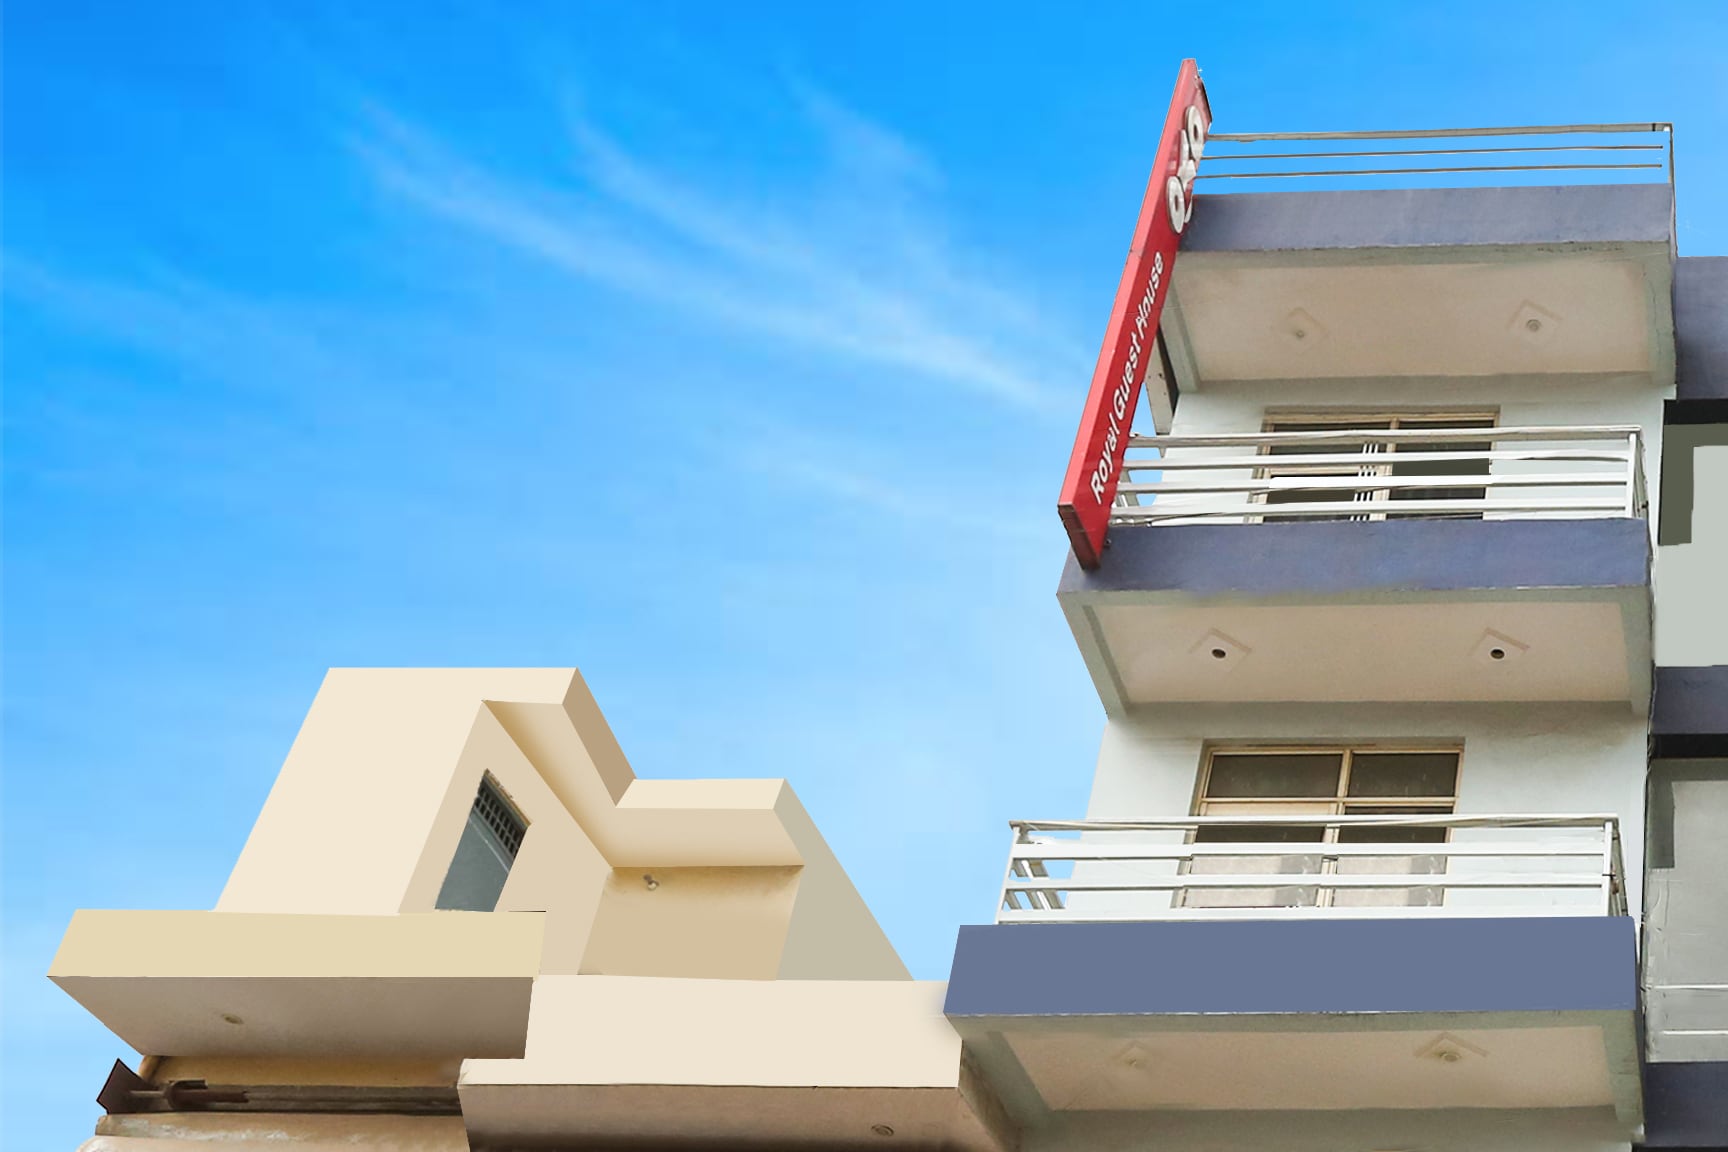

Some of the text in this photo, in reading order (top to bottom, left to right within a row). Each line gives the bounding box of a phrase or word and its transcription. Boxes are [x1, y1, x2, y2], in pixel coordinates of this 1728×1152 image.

[1090, 251, 1163, 504] Royal Guest House
